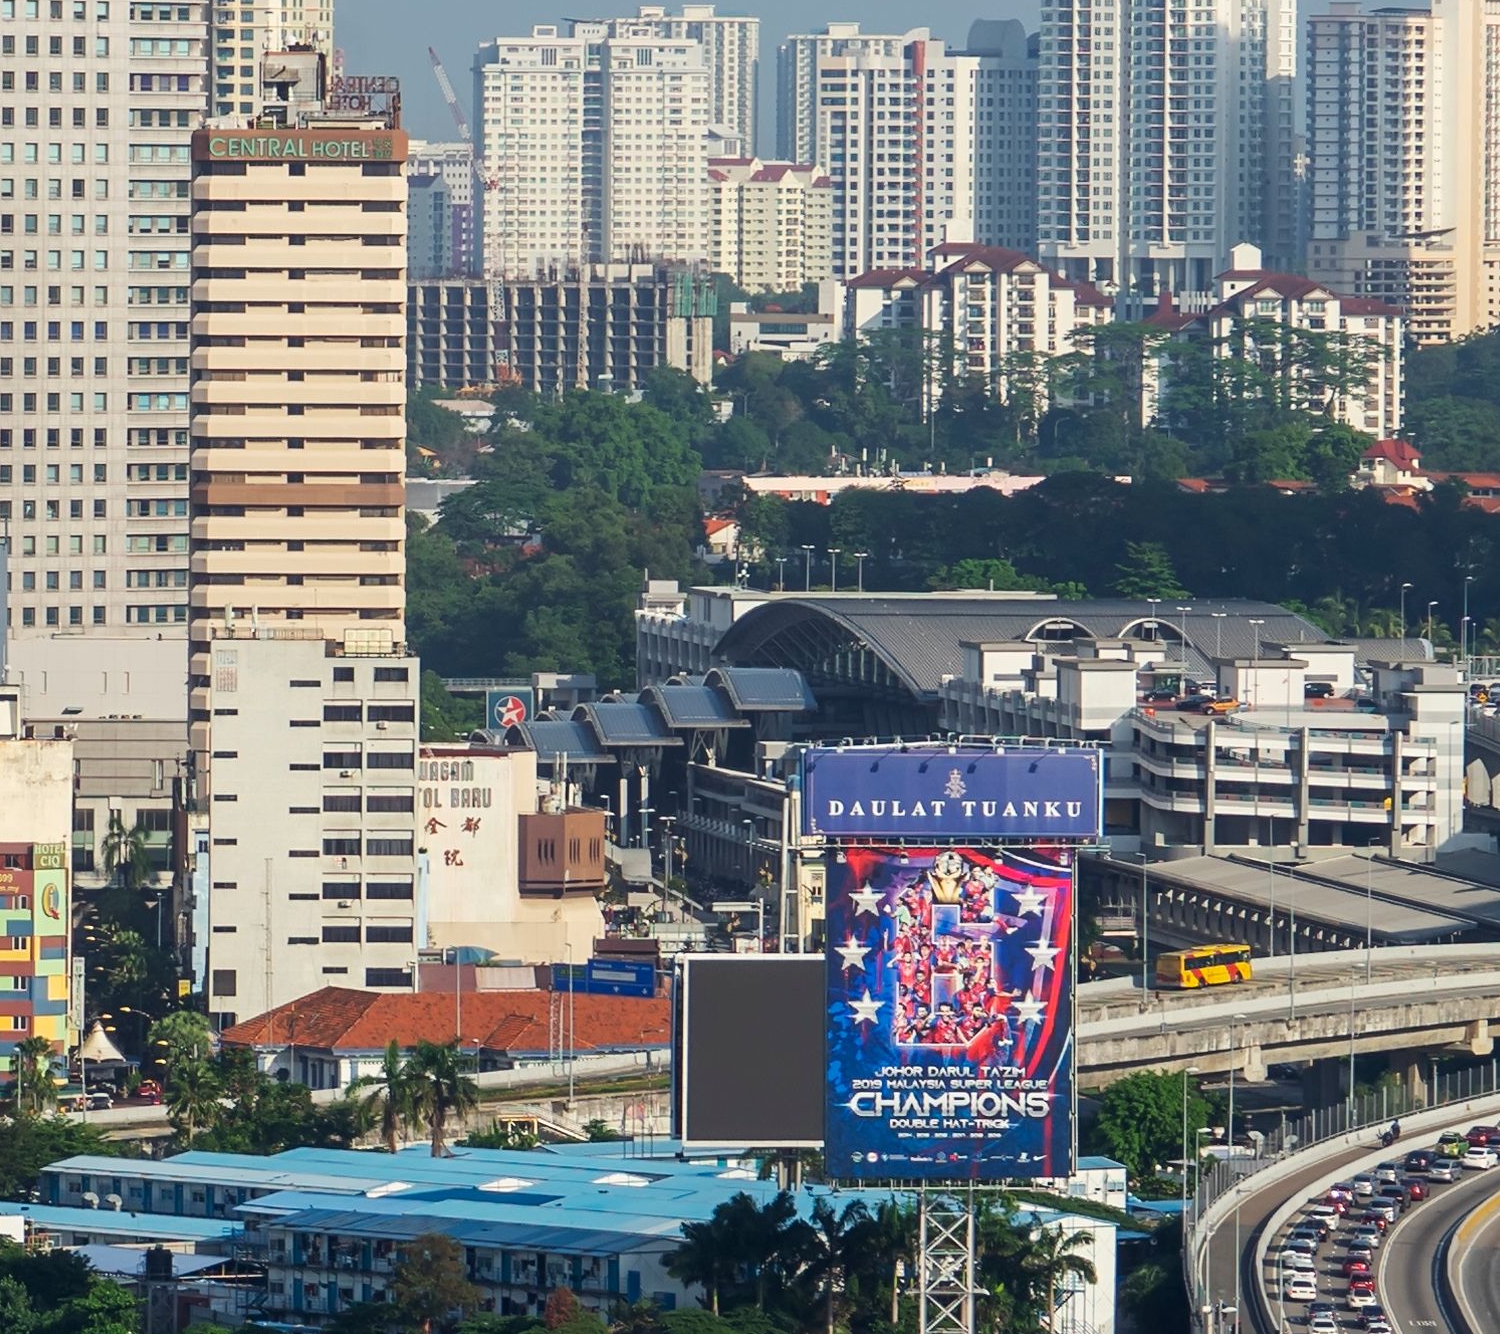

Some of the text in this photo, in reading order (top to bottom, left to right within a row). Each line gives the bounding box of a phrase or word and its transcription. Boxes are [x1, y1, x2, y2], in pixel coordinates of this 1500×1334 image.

[419, 788, 491, 808] OL BARU
[829, 801, 1082, 817] DAULAT TUANKU
[35, 843, 65, 854] HOTEL
[40, 855, 60, 867] CIQ
[875, 1067, 1025, 1077] JOHOR DARUL TA'ZIM
[852, 1080, 1049, 1089] 2019 MALAYSIA SUPER LEAGUE
[850, 1092, 1050, 1117] CHAMPIONS
[890, 1119, 1011, 1128] DOUBLE HAT-TRICK
